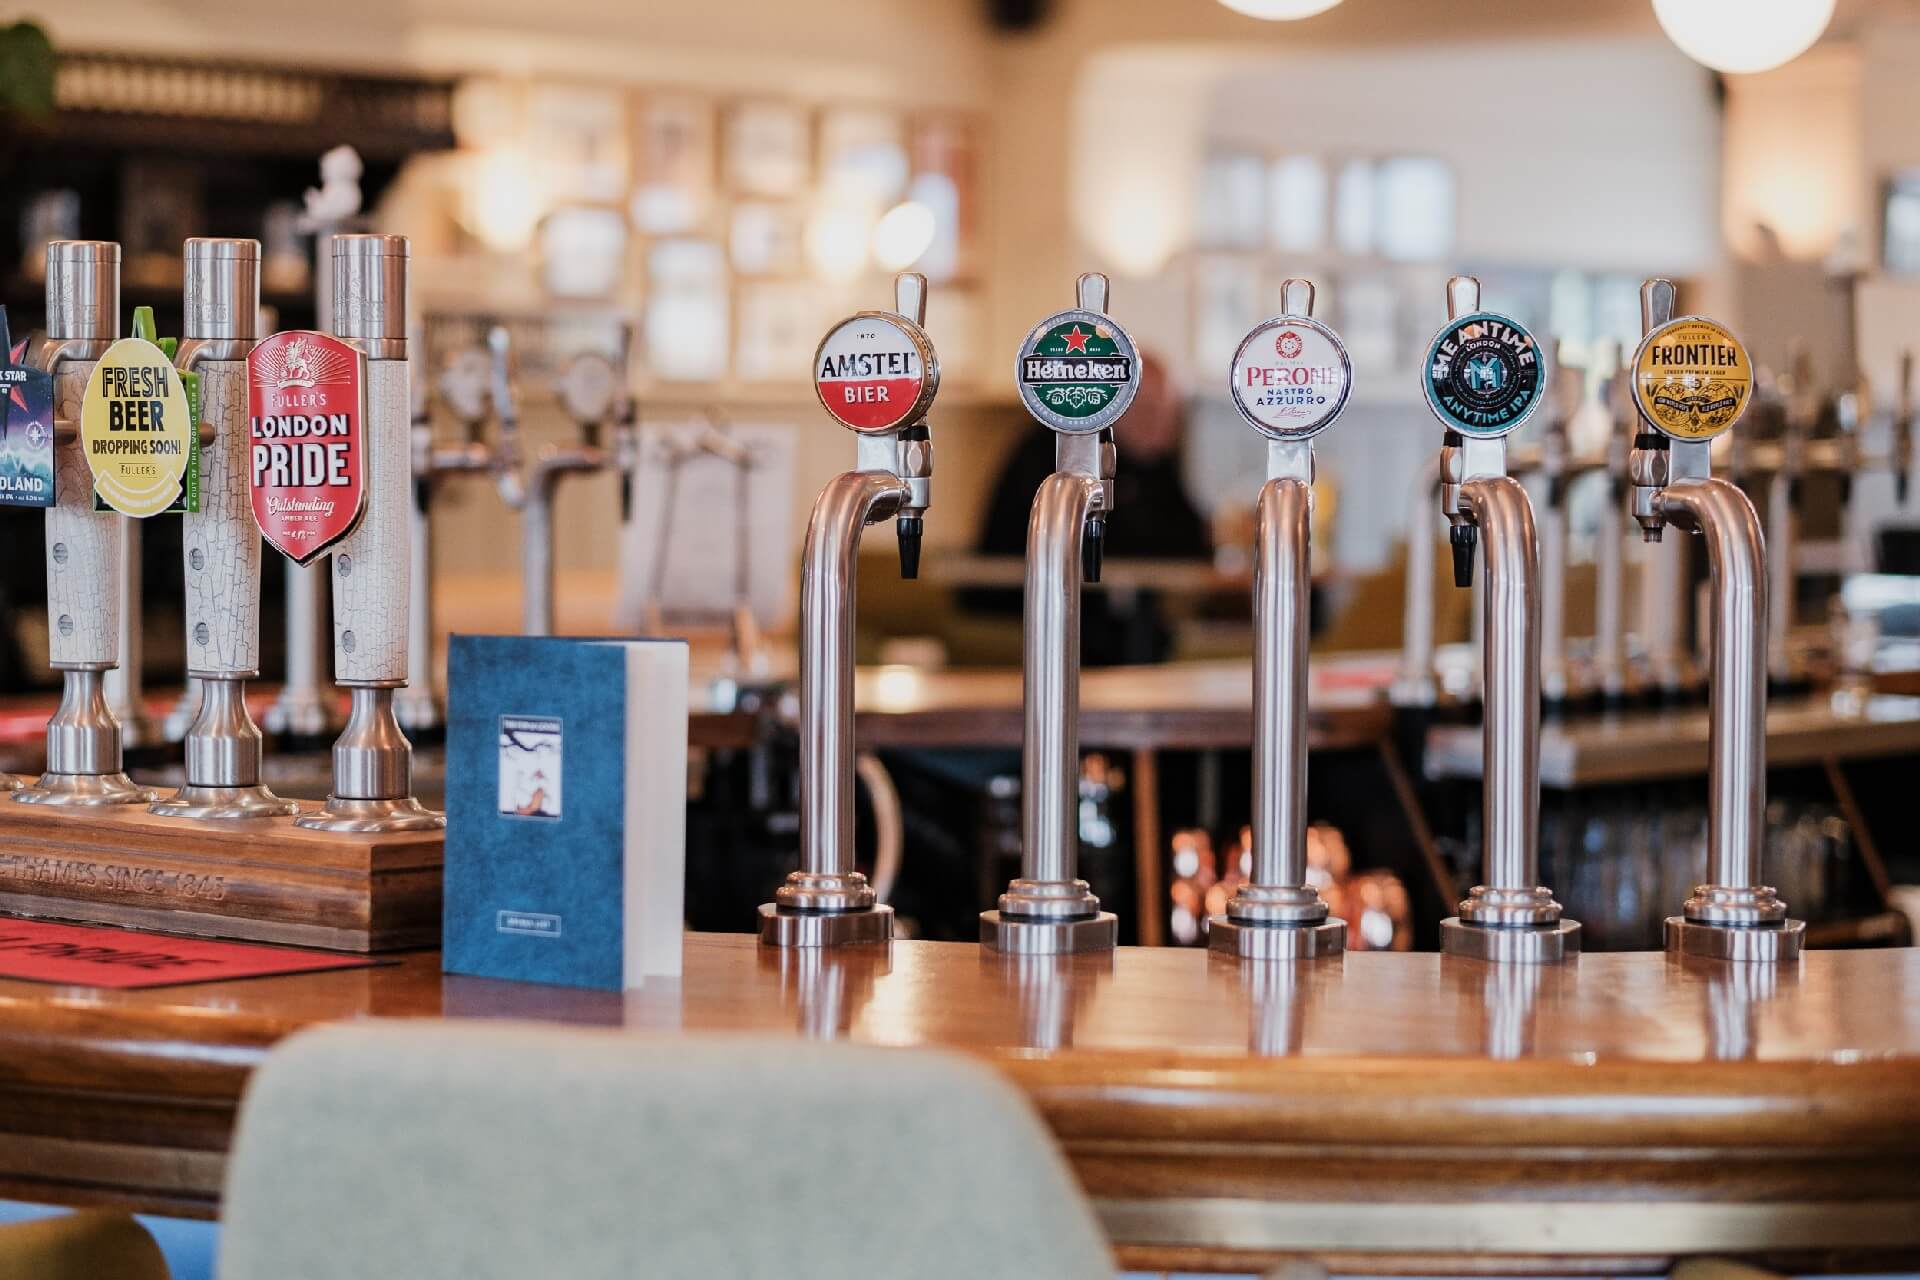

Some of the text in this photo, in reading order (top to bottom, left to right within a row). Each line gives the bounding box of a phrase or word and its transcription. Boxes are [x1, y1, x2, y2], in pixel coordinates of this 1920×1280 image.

[1432, 320, 1535, 379] MEANTIME
[1652, 344, 1737, 366] FRONTIER
[821, 352, 911, 378] AMSTEL
[1026, 360, 1127, 379] Heineken
[5, 371, 27, 381] STAR
[103, 367, 169, 397] FRESH
[272, 392, 327, 408] FULLER'S
[845, 385, 890, 403] BIER
[1256, 396, 1326, 406] AZZURRO
[1267, 387, 1313, 396] NASTRO
[110, 401, 164, 431] BEER
[1443, 390, 1531, 424] ANYTIME IPA
[251, 414, 350, 438] LONDON
[93, 439, 181, 455] DROPPING SOON!
[121, 464, 156, 475] FULLER'S
[191, 469, 197, 479] OF
[253, 442, 351, 487] PRIDE
[266, 496, 335, 517] Outstanding
[11, 854, 98, 887] THAMES
[103, 864, 167, 893] SINCE
[175, 871, 226, 900] 1845
